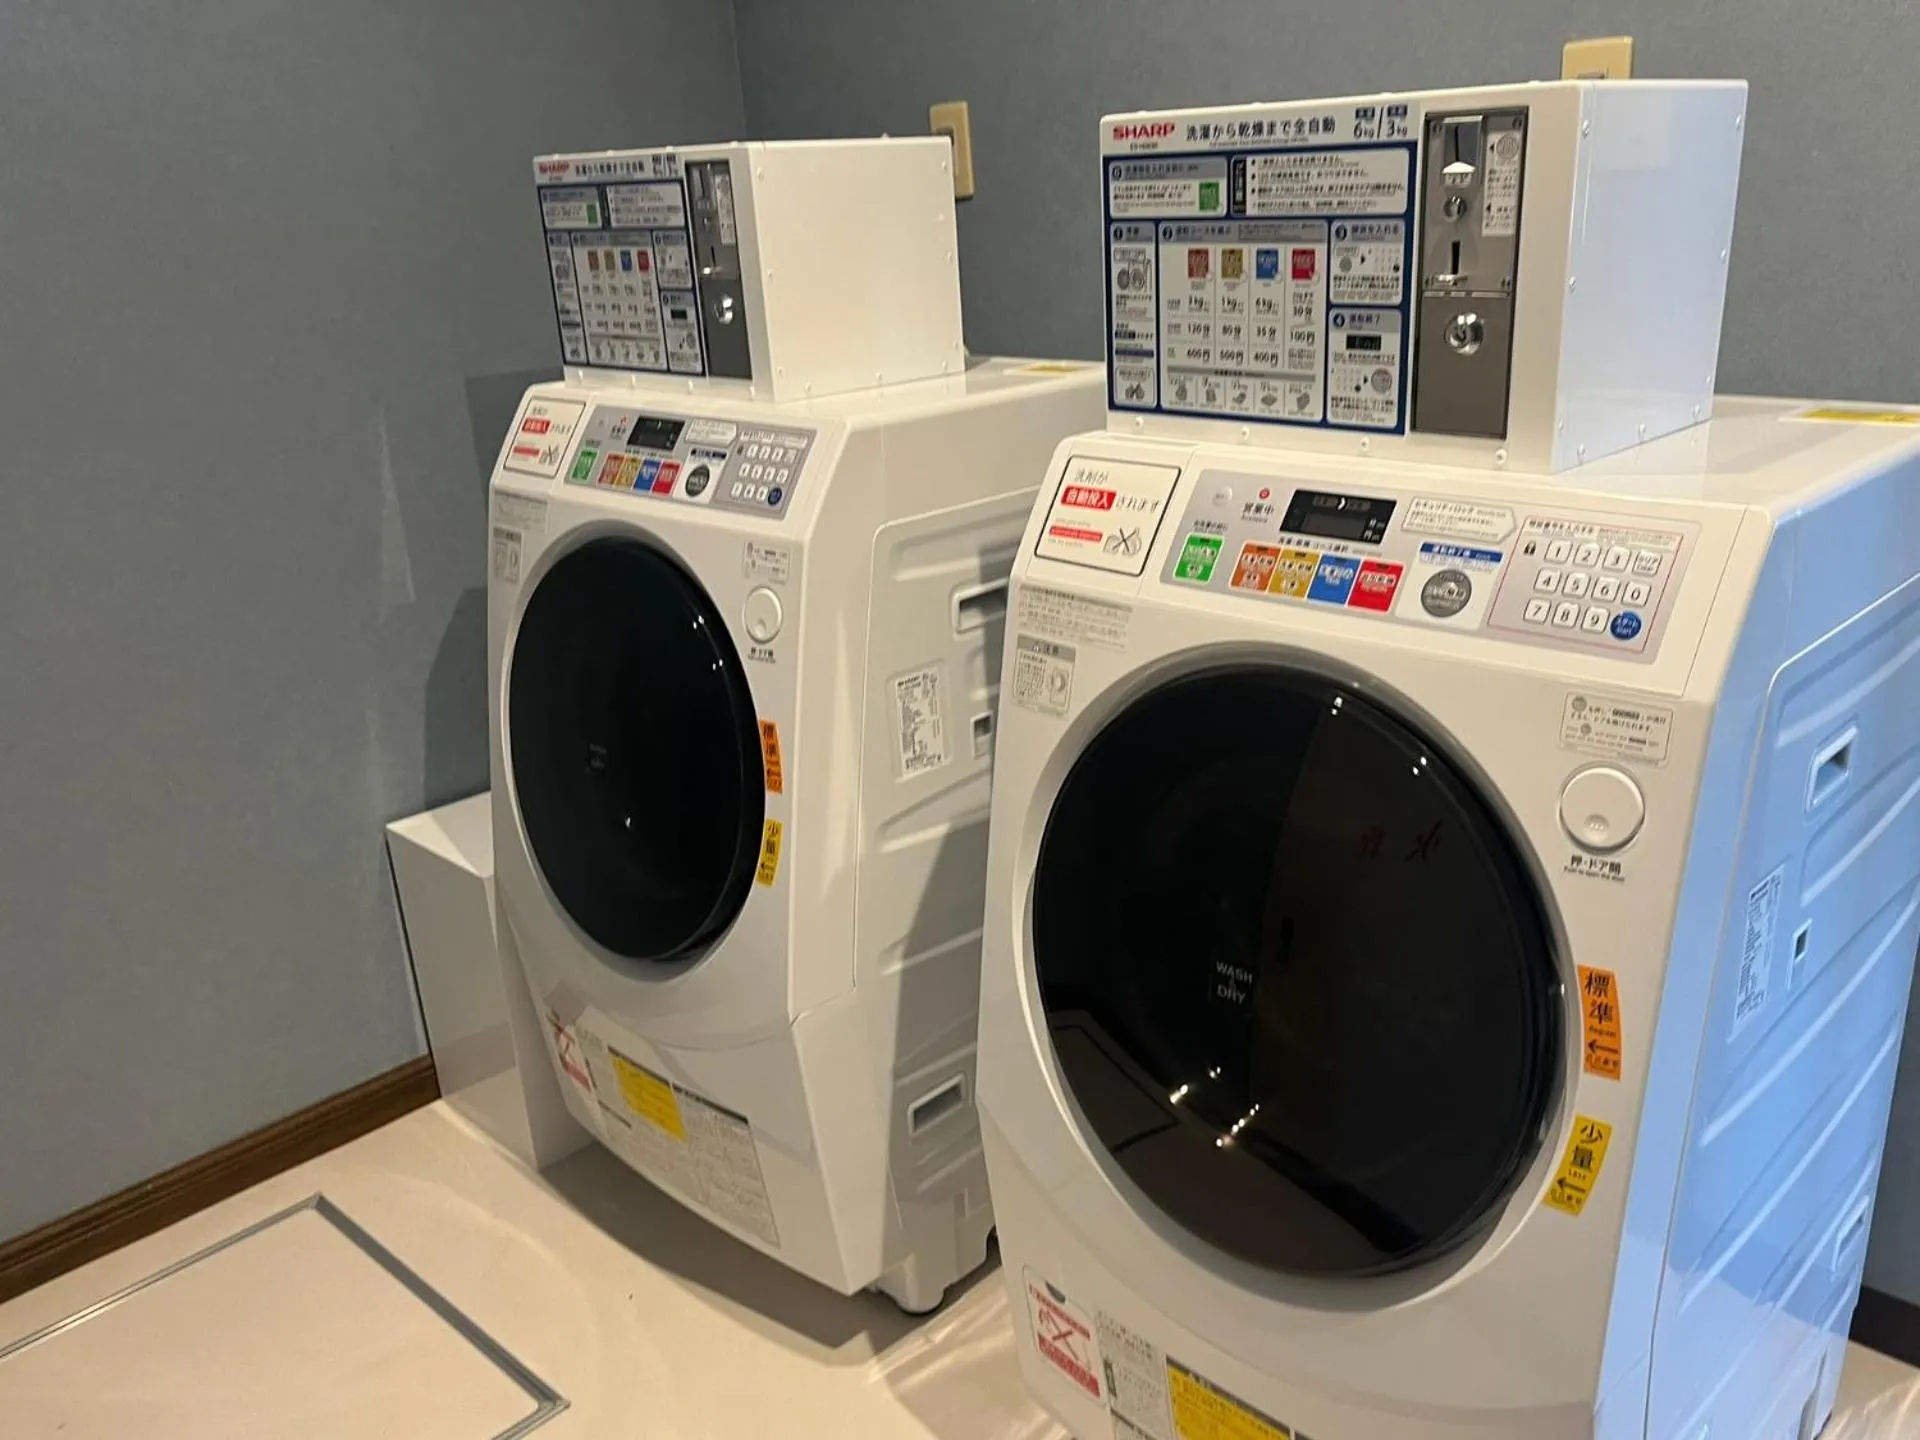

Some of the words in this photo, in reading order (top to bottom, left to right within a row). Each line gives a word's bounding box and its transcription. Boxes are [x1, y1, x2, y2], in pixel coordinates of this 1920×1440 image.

[1112, 122, 1175, 140] SHARP
[1186, 115, 1336, 142] 洗濯から乾燥まで全自動
[1065, 486, 1109, 508] 自動投入
[1582, 550, 1591, 561] 2
[1543, 576, 1552, 588] 4
[1600, 583, 1610, 597] 6
[1630, 587, 1641, 601] 0
[1532, 604, 1542, 617] 7
[1560, 609, 1570, 622] 8
[1590, 613, 1600, 626] 9
[1215, 959, 1254, 986] WASH
[1216, 982, 1247, 1005] DRY
[1584, 970, 1614, 1026] 標準
[1571, 1122, 1604, 1173] 少量
